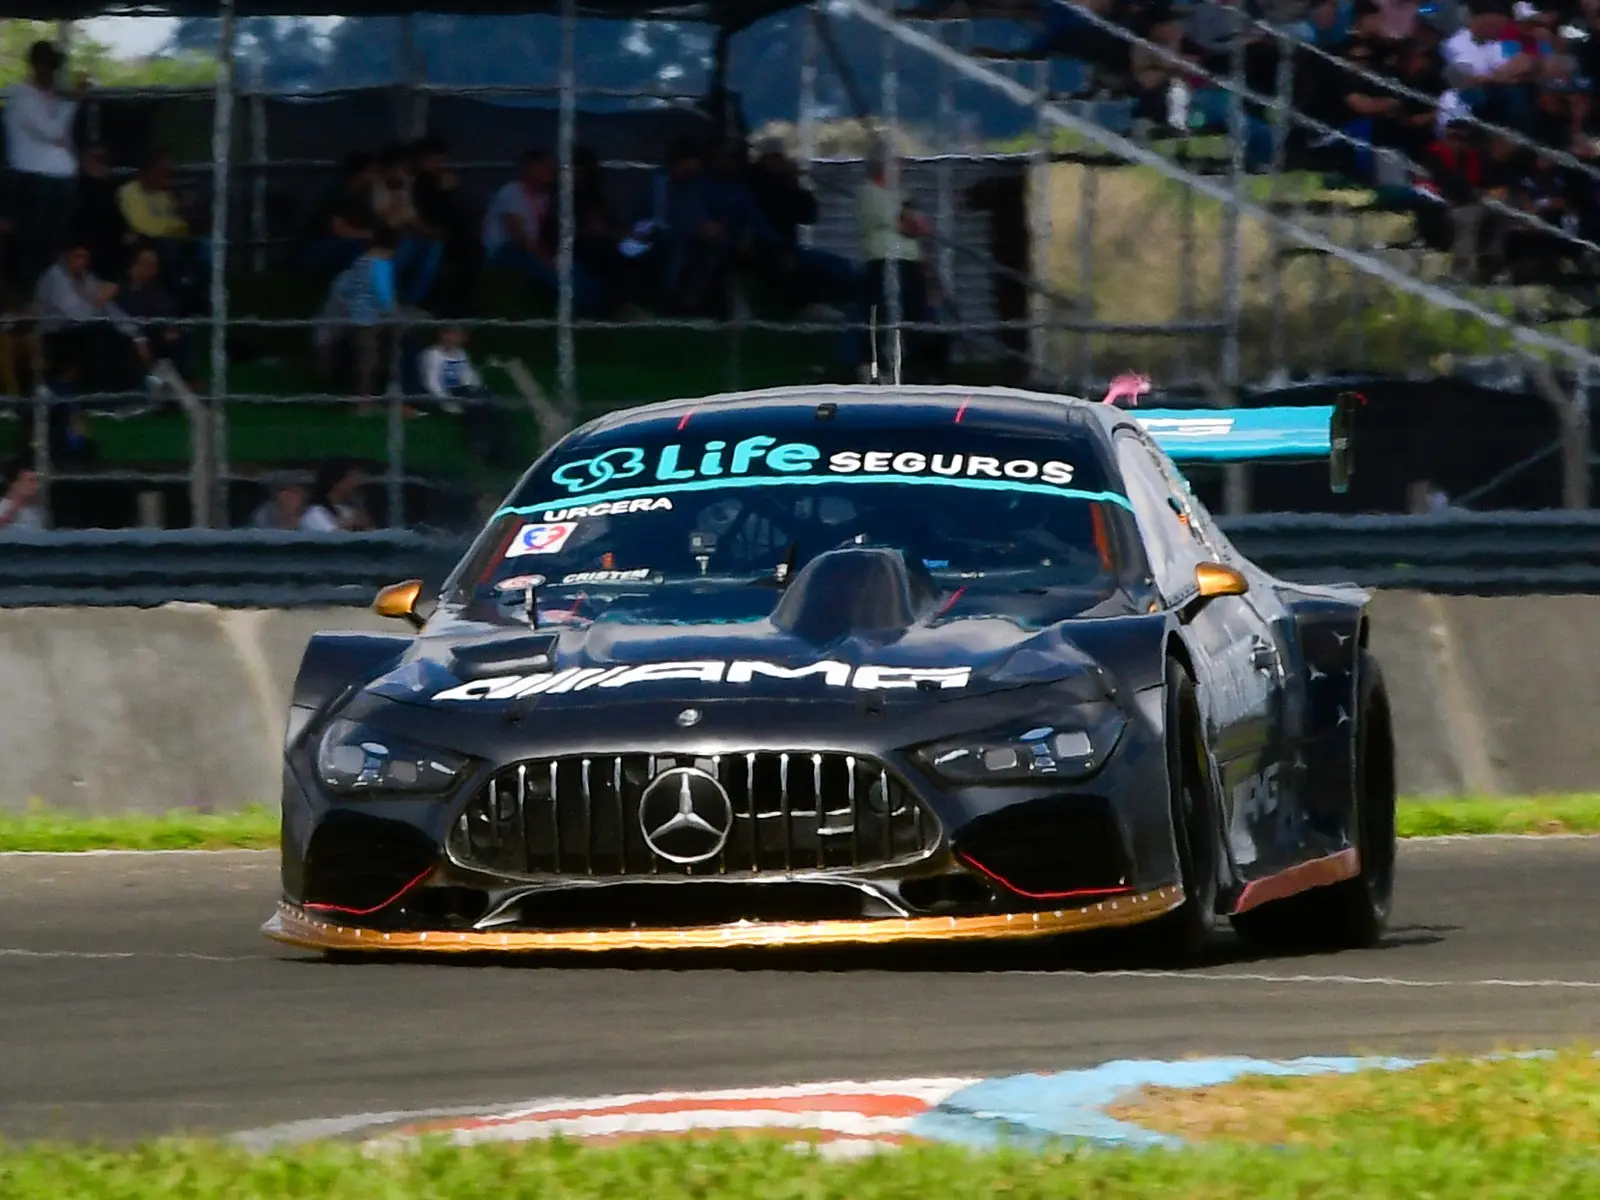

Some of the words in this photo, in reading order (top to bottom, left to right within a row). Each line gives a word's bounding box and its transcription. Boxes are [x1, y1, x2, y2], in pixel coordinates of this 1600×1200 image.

[656, 436, 820, 480] Life
[828, 451, 1074, 484] SEGUROS
[543, 497, 673, 522] URCERA
